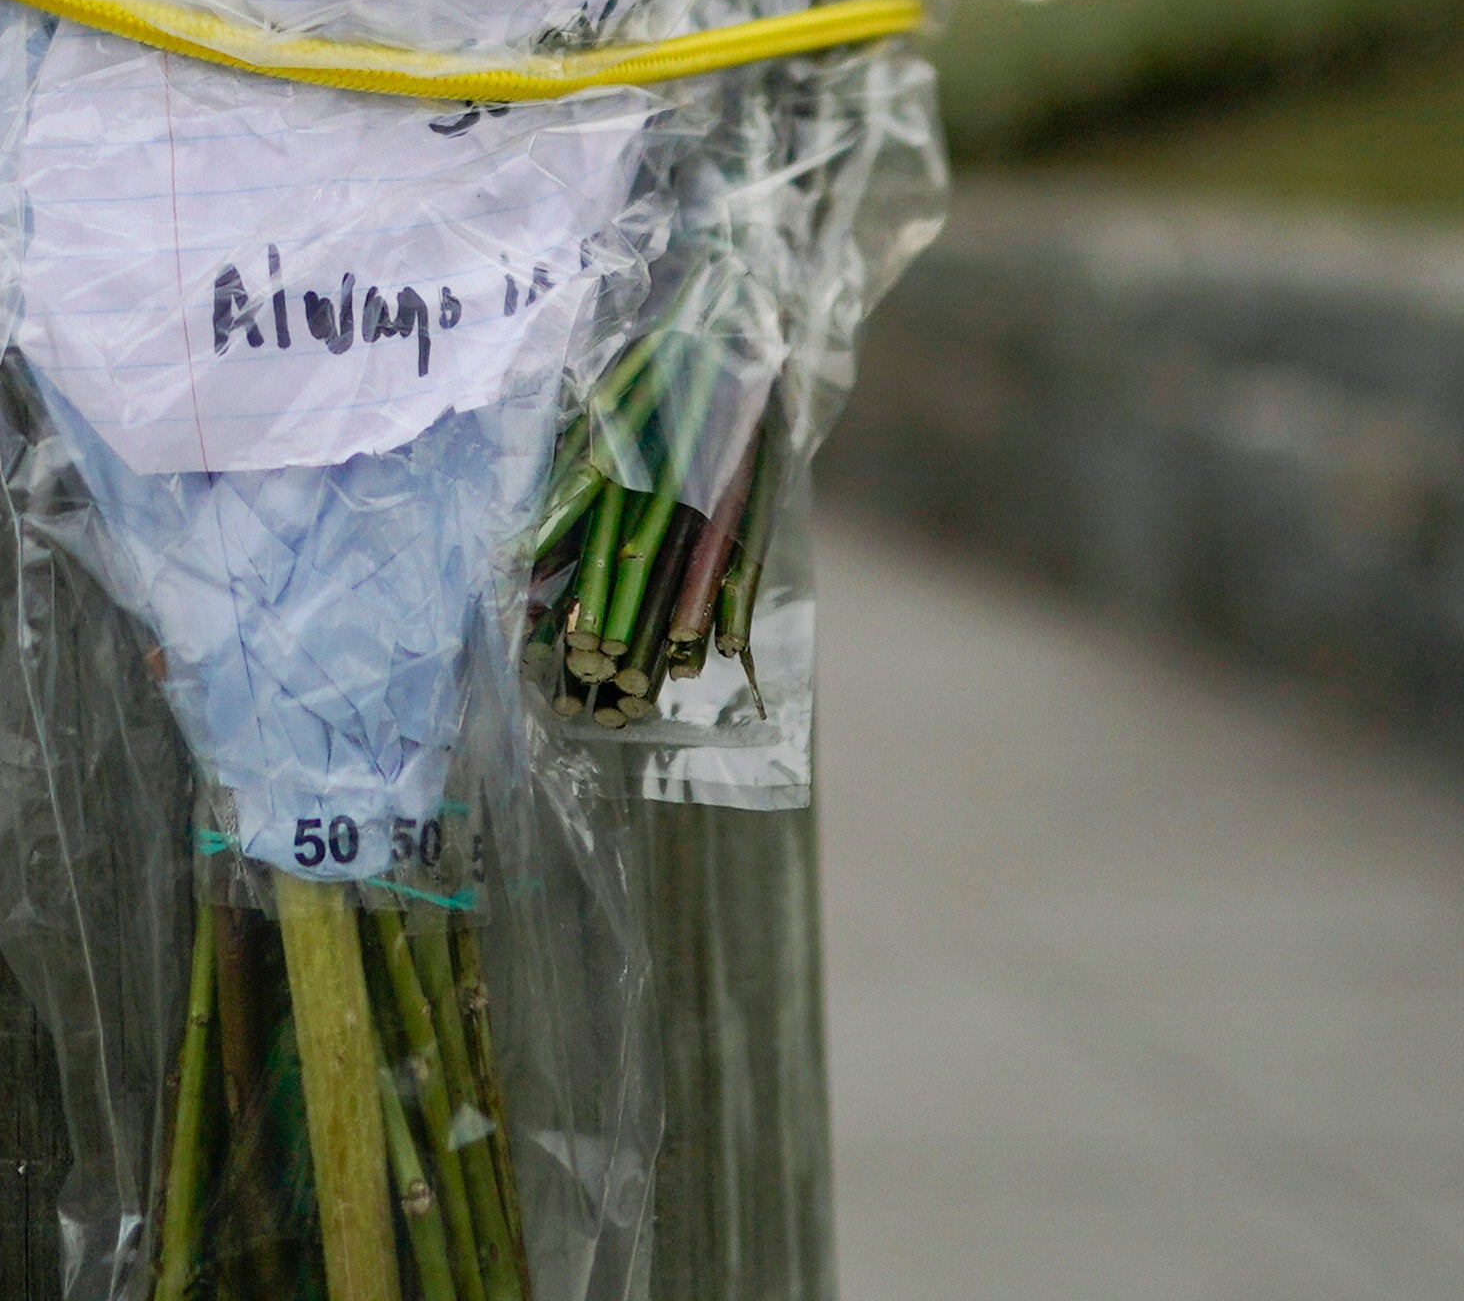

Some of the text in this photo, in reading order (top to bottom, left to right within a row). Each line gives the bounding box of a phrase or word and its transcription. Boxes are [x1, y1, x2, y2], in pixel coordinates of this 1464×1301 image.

[212, 243, 463, 378] Always
[293, 814, 360, 867] 50
[390, 817, 443, 868] 50
